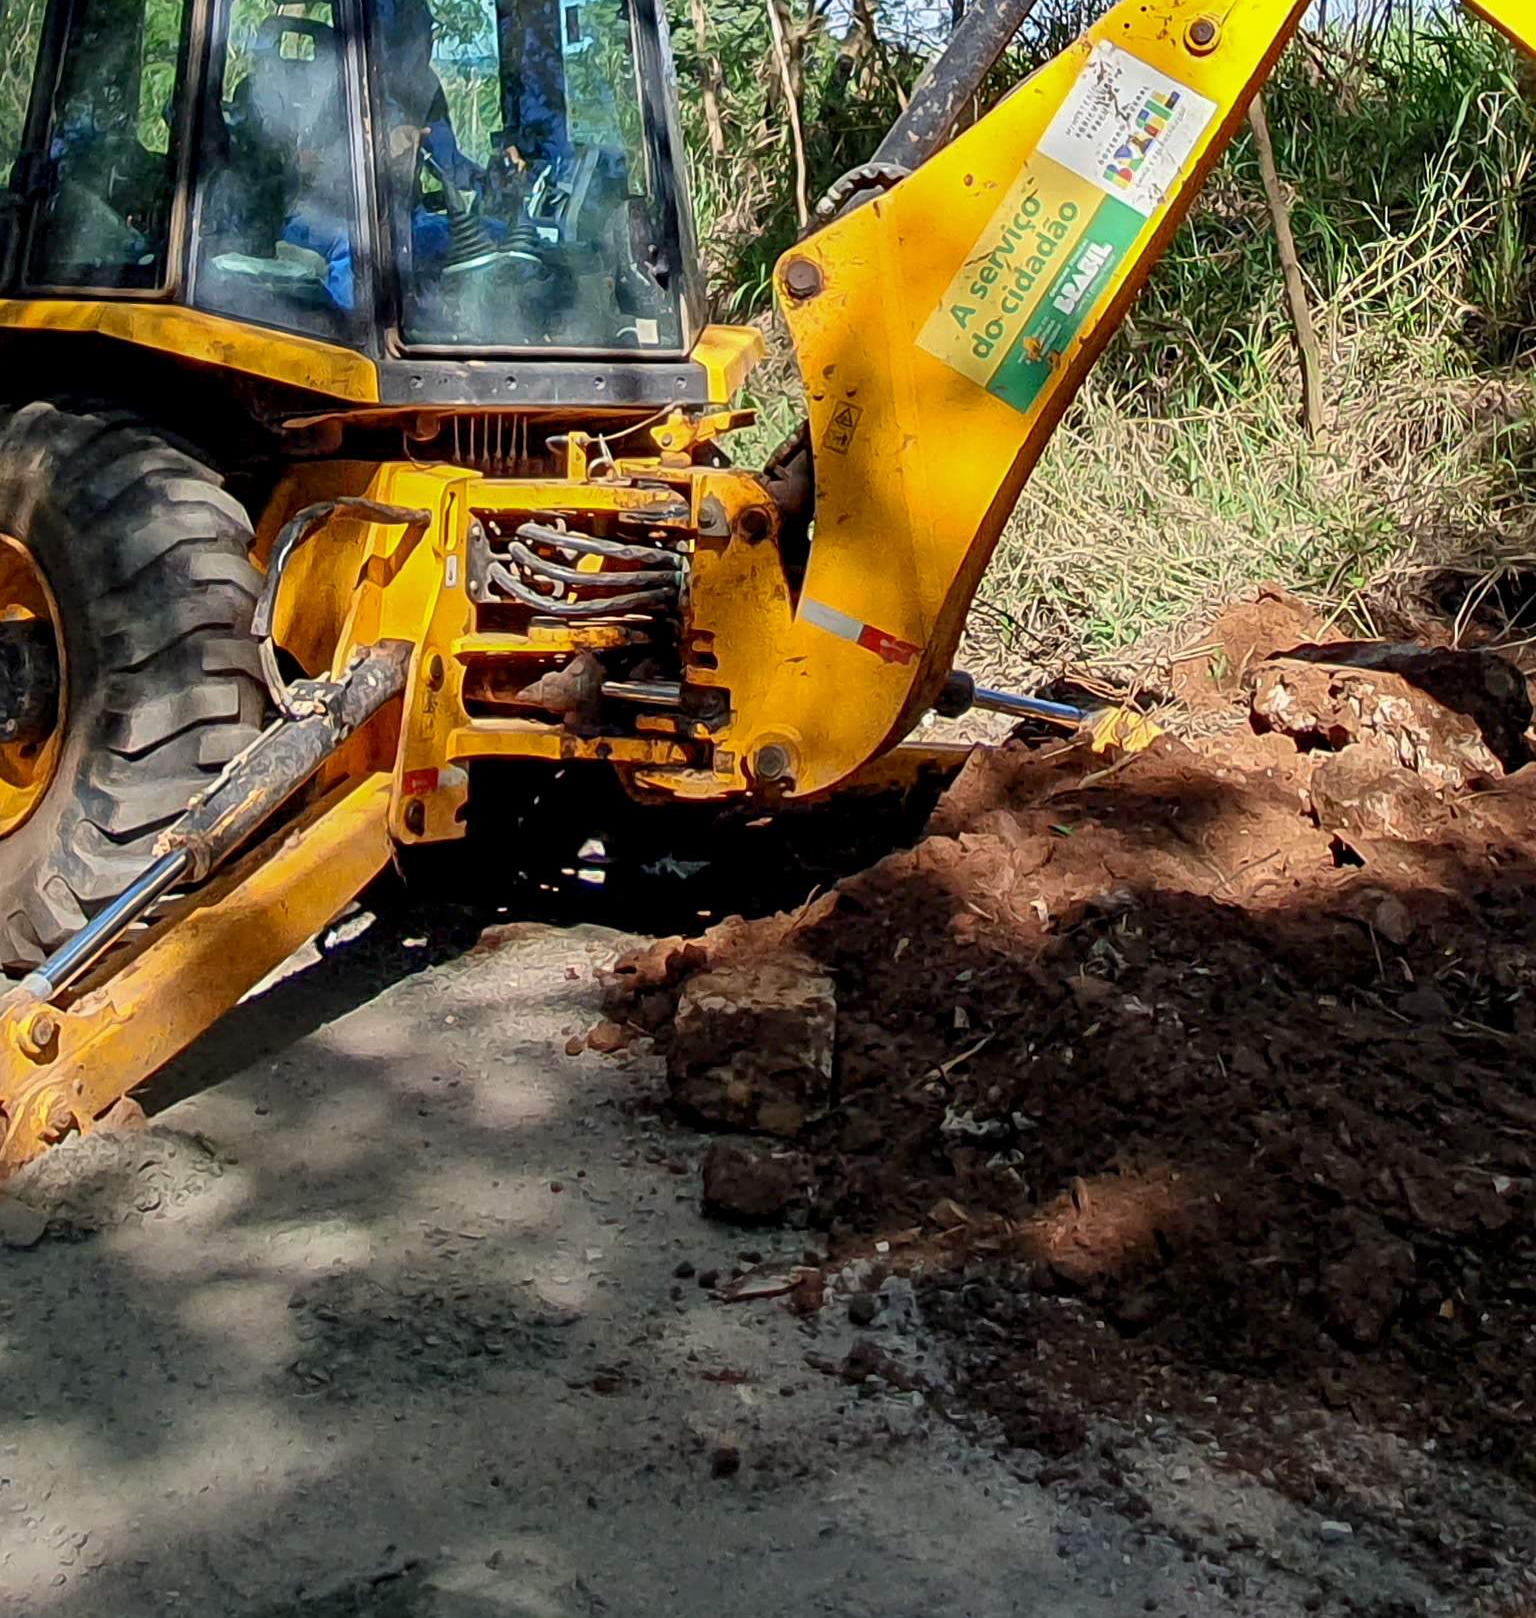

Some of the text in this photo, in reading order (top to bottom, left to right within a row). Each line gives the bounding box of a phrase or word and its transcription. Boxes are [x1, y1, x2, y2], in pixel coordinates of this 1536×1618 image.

[951, 304, 976, 330] A
[970, 197, 1041, 300] serviço
[972, 319, 1004, 359] do
[1001, 202, 1078, 314] cidadão
[1053, 242, 1114, 315] BRASIL
